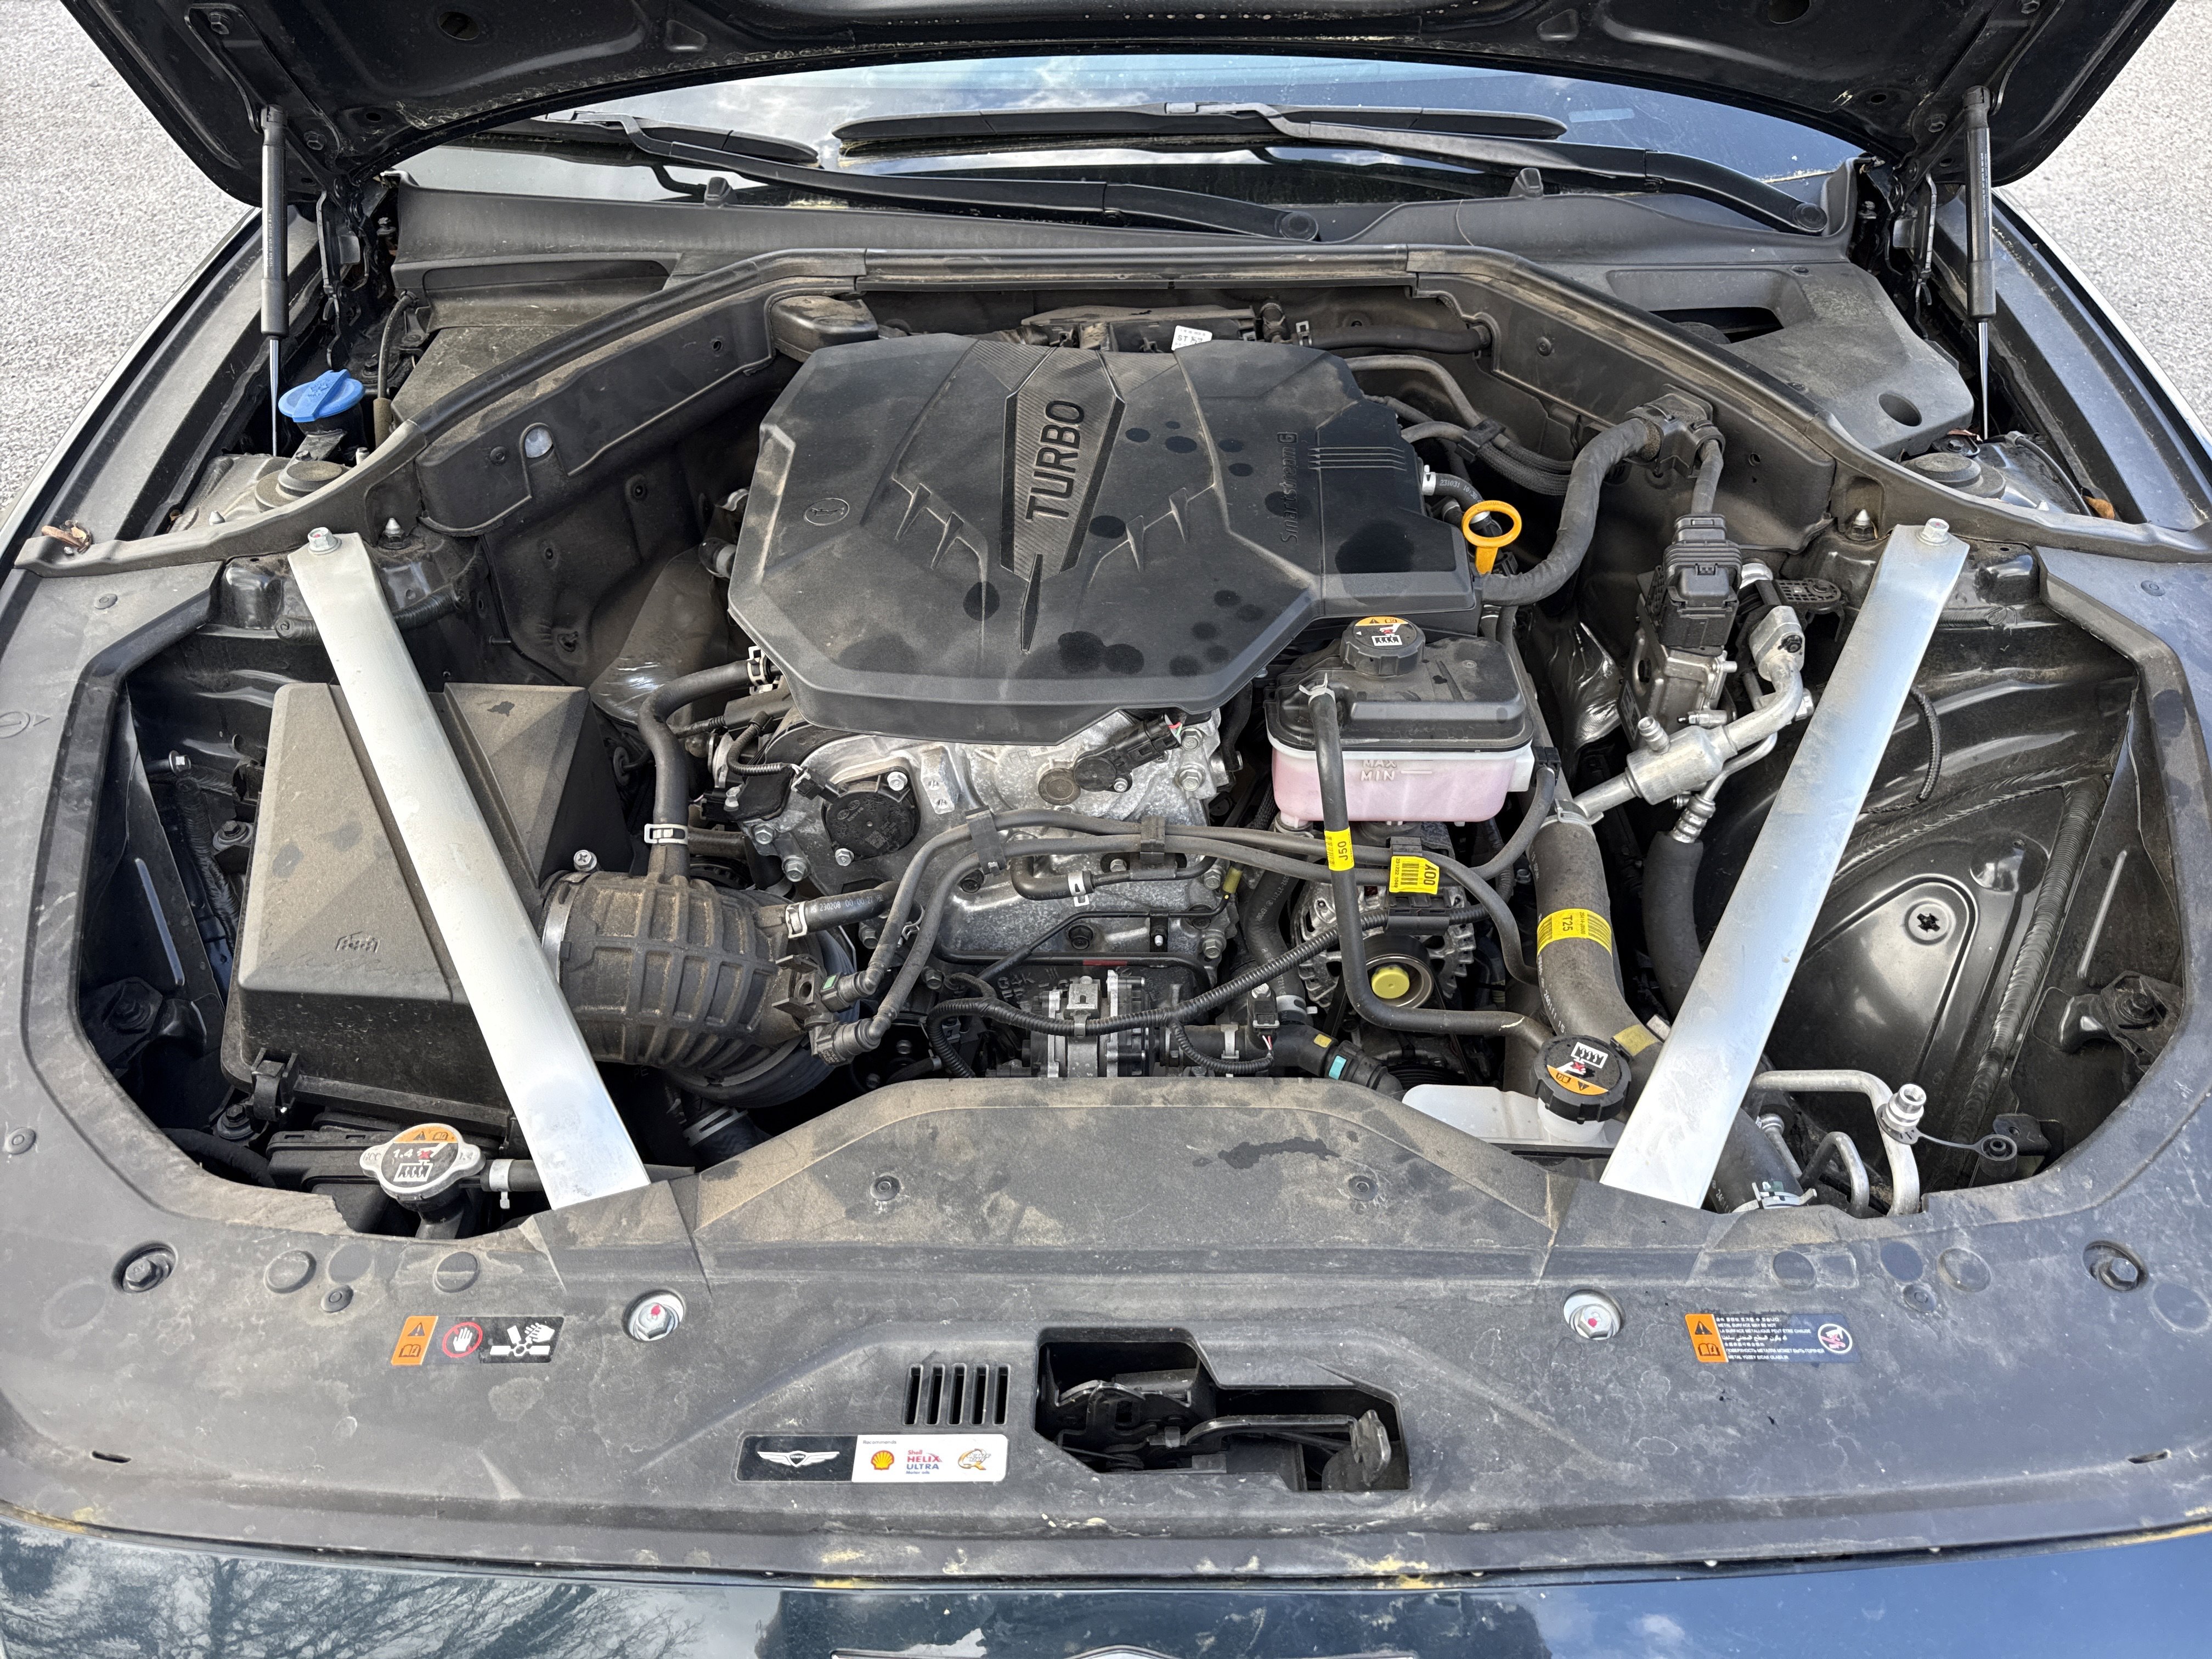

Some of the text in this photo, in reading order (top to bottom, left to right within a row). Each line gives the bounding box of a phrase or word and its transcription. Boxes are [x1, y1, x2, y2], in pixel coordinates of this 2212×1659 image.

[1025, 400, 1085, 522] TURBO
[1440, 479, 1460, 488] 231031
[1279, 447, 1299, 543] Smartstream
[1362, 759, 1397, 769] MAX
[1361, 770, 1396, 782] MIN
[1337, 840, 1348, 861] J50
[1423, 863, 1437, 886] A00
[820, 901, 841, 912] 230208
[1562, 915, 1573, 932] T25
[393, 1149, 414, 1158] 1.4
[907, 1454, 942, 1463] HELIX
